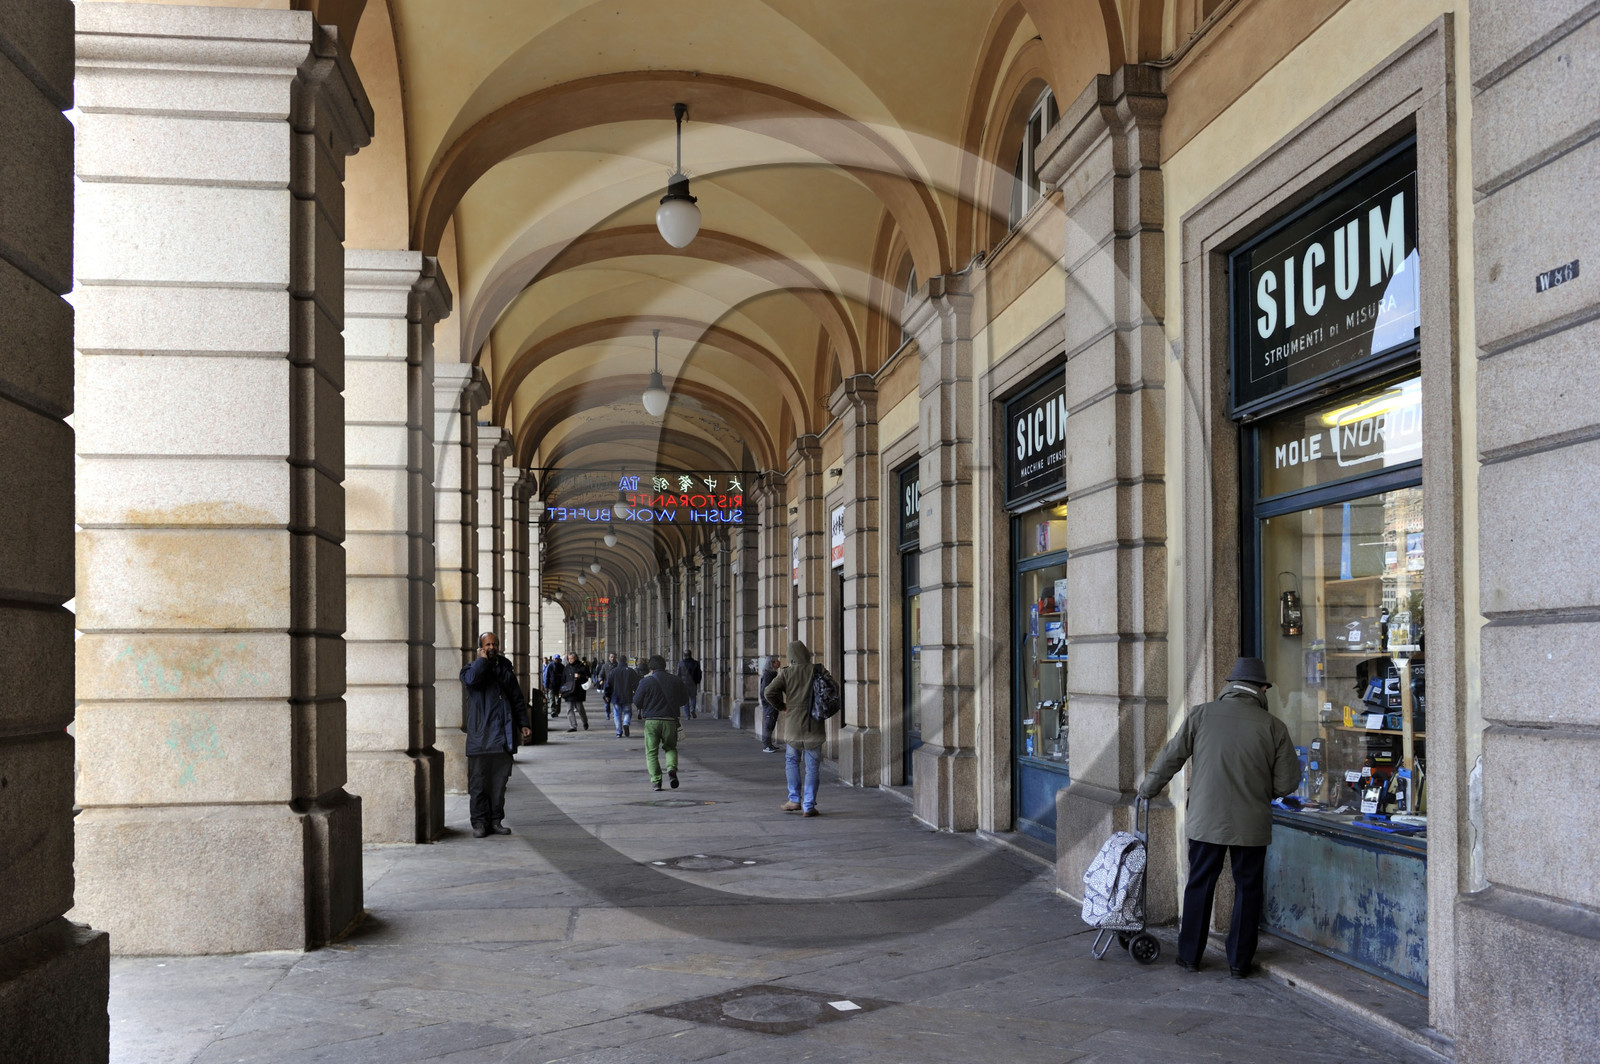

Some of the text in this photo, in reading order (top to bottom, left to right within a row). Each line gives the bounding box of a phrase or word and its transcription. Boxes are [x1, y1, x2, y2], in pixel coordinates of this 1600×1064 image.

[1257, 191, 1405, 339] SICUM
[1264, 327, 1323, 366] STRUMENTI
[1346, 294, 1397, 329] MISURA
[1275, 405, 1422, 469] MOLE NORTO
